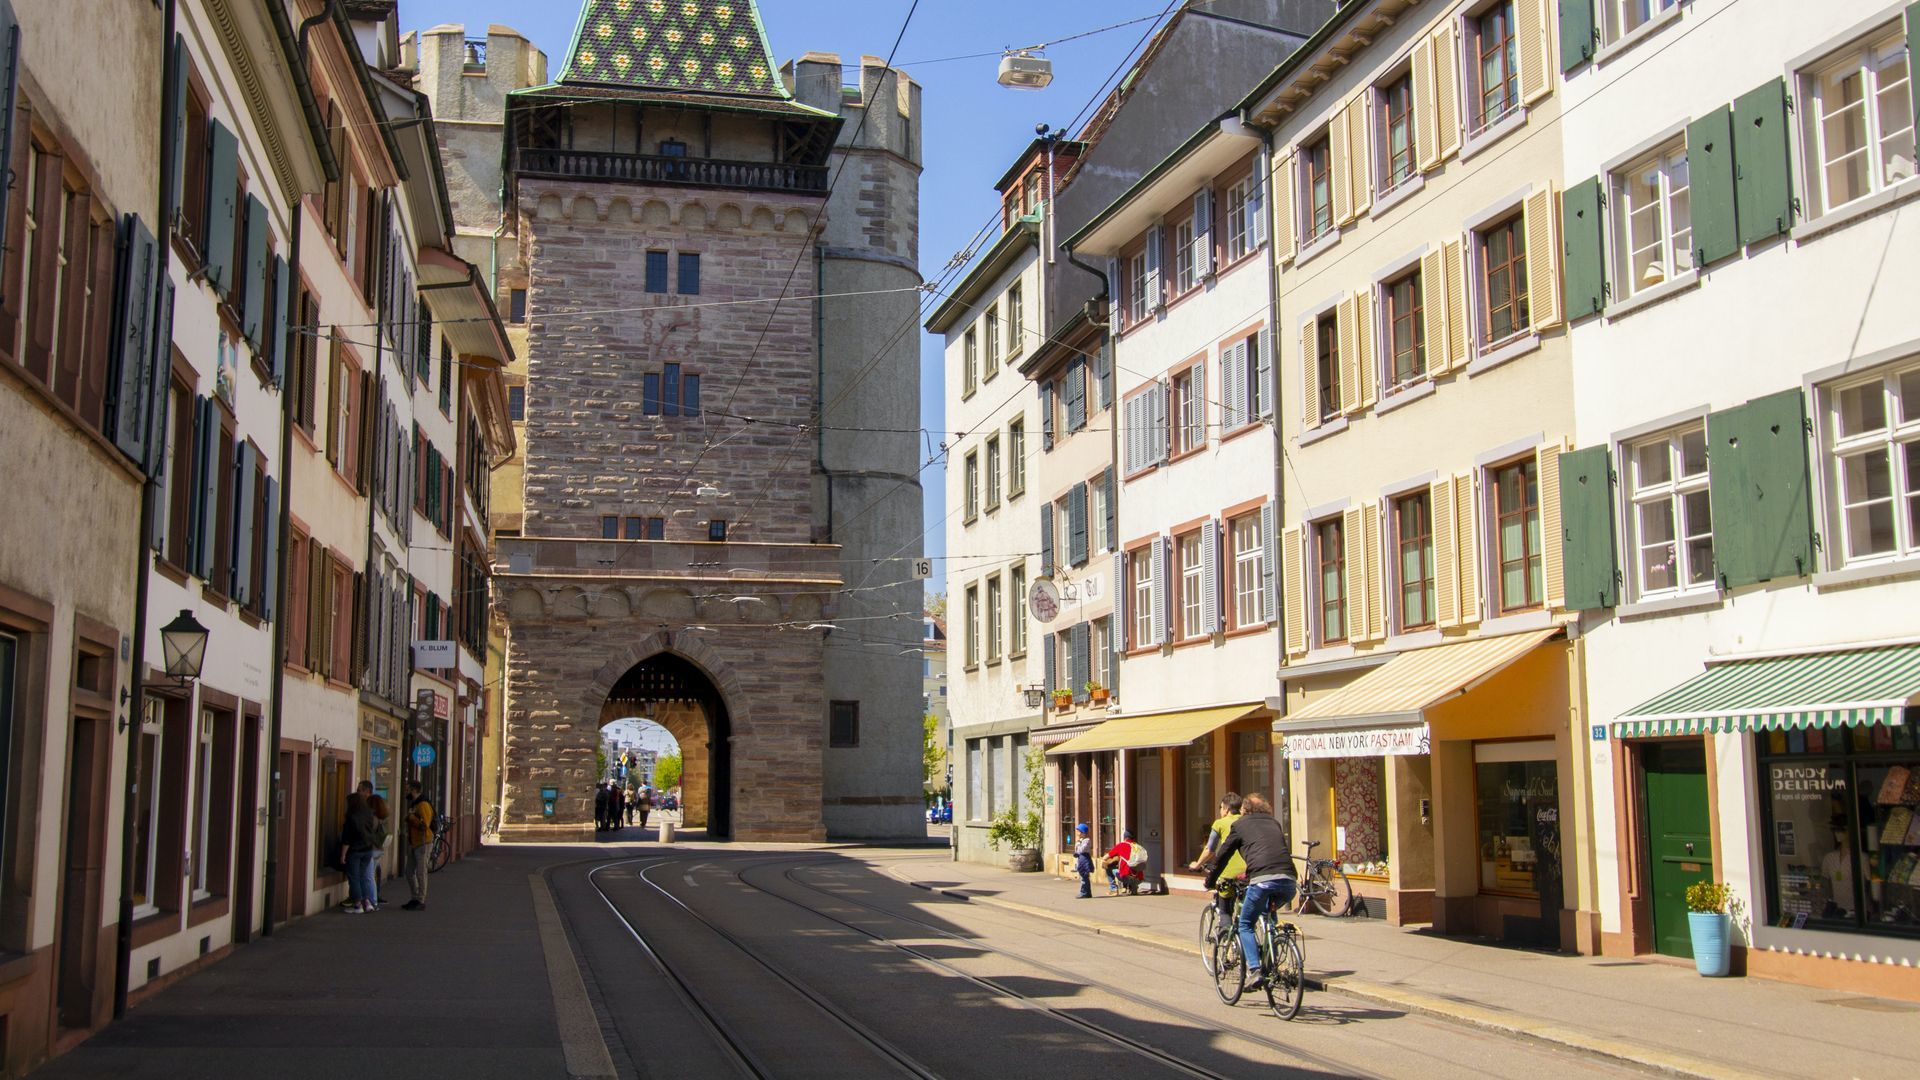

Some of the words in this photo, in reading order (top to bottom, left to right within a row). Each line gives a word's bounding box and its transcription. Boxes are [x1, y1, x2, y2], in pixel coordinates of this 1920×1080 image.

[916, 562, 929, 576] 16
[1594, 727, 1603, 738] 32
[1292, 735, 1326, 751] ORIGINAL
[1329, 736, 1345, 749] NEW
[1347, 735, 1369, 749] YORK
[1371, 732, 1414, 748] PASTRAMI
[1773, 768, 1826, 778] DANDY
[1773, 779, 1847, 790] DELIRIUM
